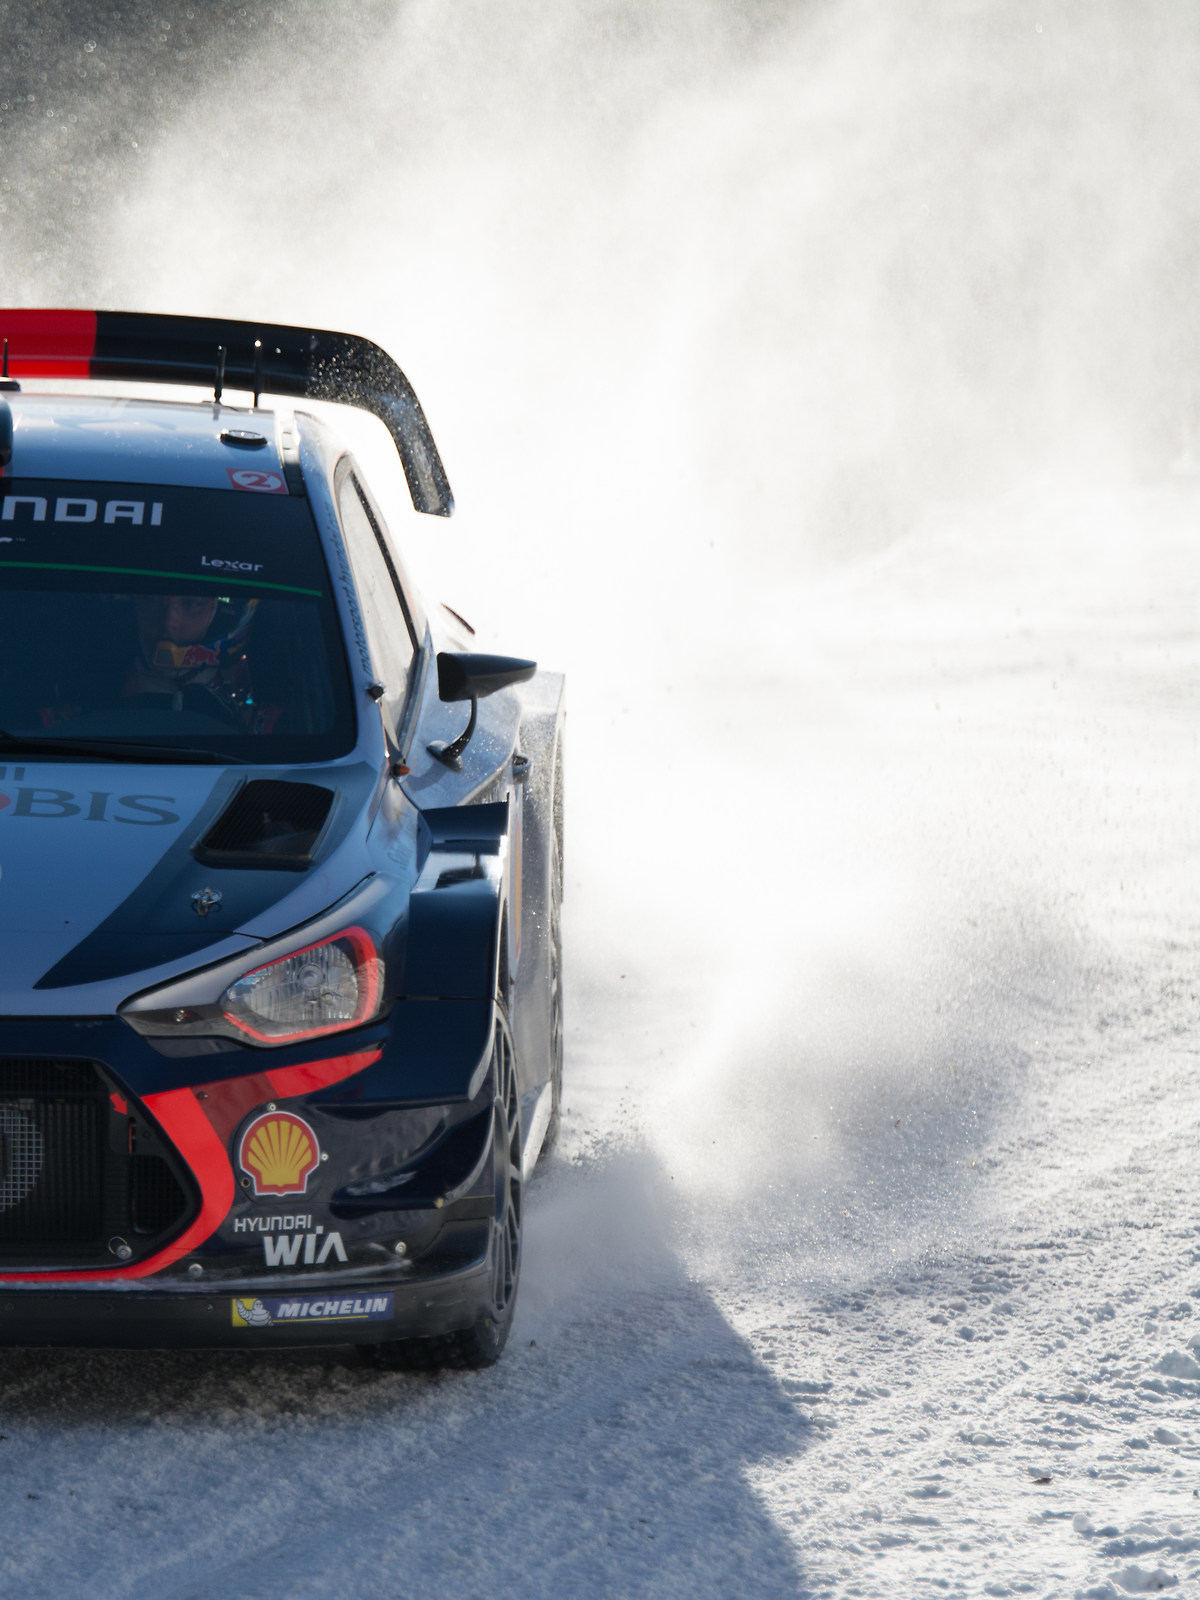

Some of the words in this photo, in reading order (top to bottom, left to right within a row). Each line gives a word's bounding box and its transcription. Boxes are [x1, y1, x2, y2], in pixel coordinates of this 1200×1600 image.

[201, 556, 264, 572] Lexar
[234, 1215, 312, 1233] HYUNDAI
[277, 1297, 388, 1318] MICHELIN
